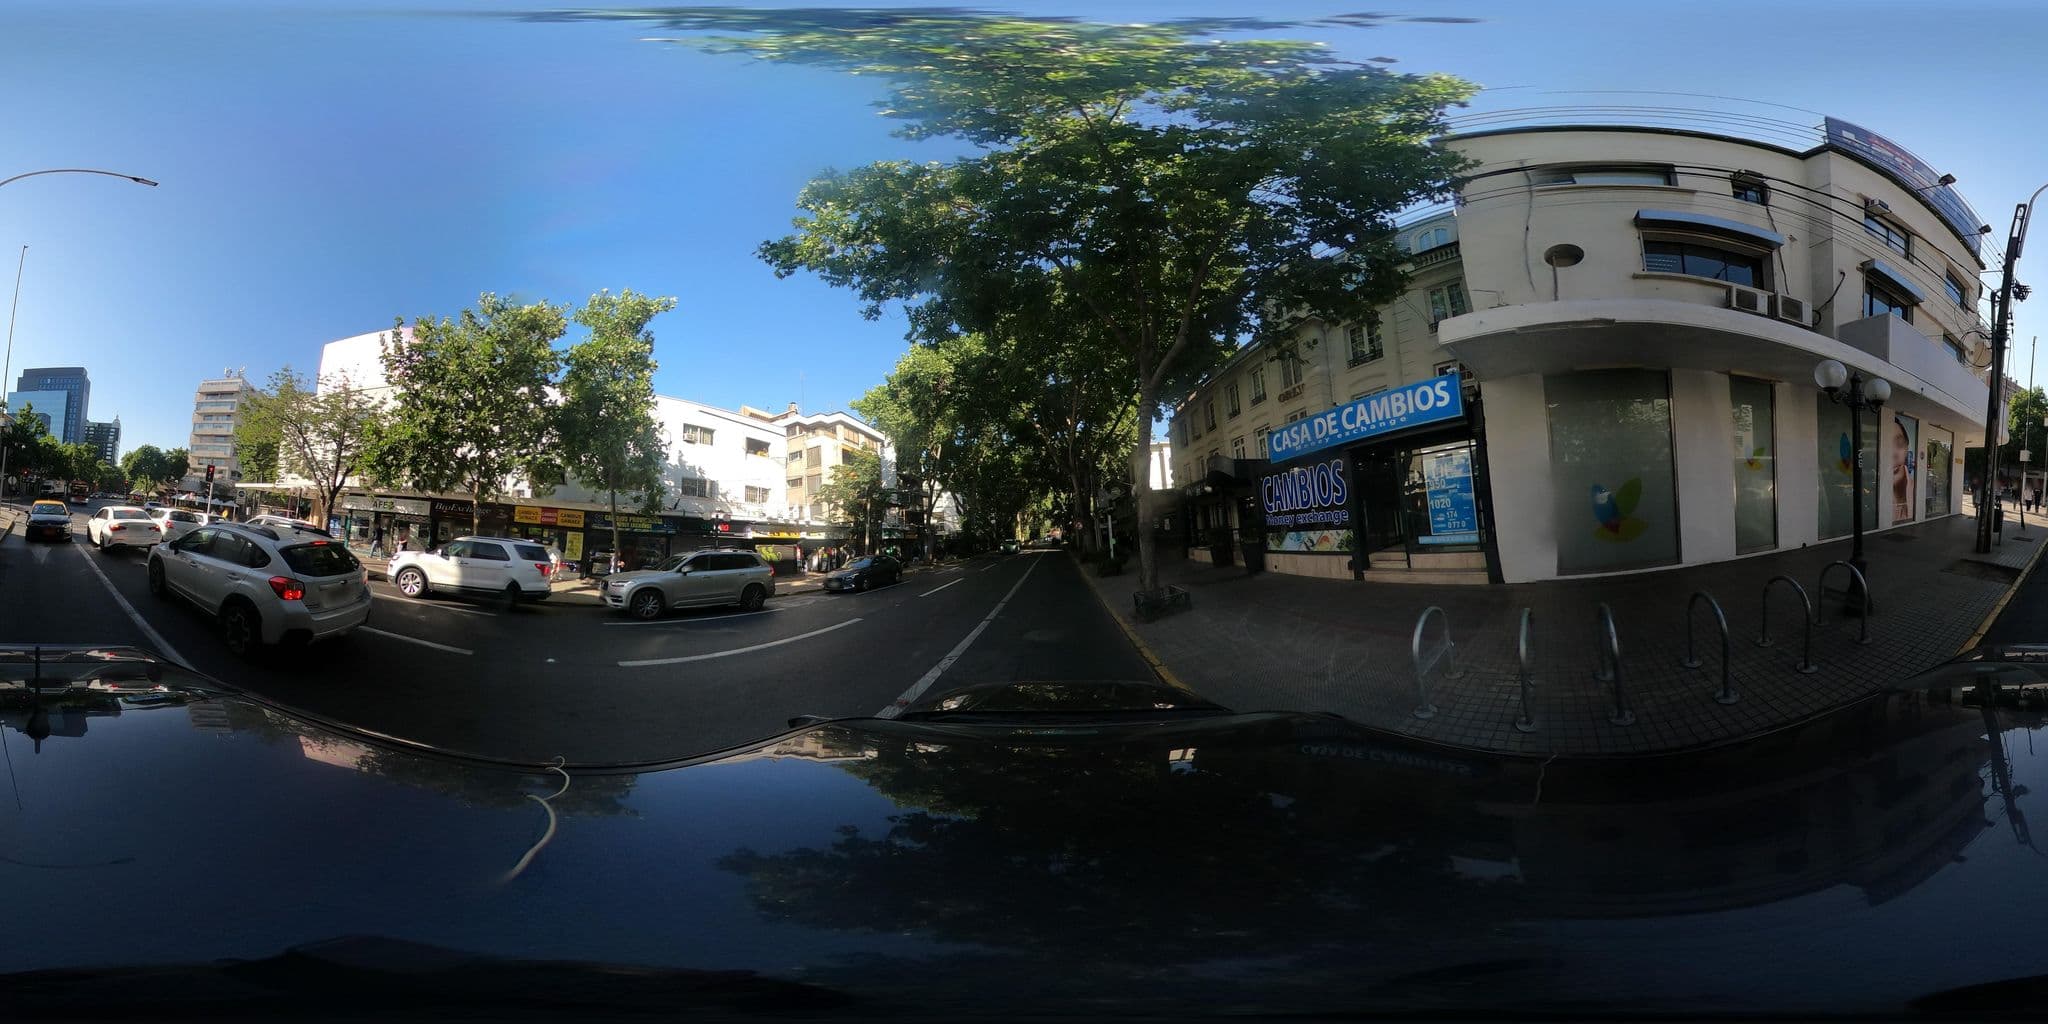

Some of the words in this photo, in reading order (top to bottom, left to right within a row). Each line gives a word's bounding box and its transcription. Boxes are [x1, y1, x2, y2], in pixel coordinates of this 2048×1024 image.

[1272, 423, 1312, 453] CASA
[1314, 412, 1339, 440] DE
[1341, 380, 1450, 430] CAMBIOS
[1337, 416, 1407, 439] exchange
[1262, 459, 1347, 513] CAMBIOS
[1430, 498, 1451, 509] 1020
[1295, 509, 1349, 525] exchange
